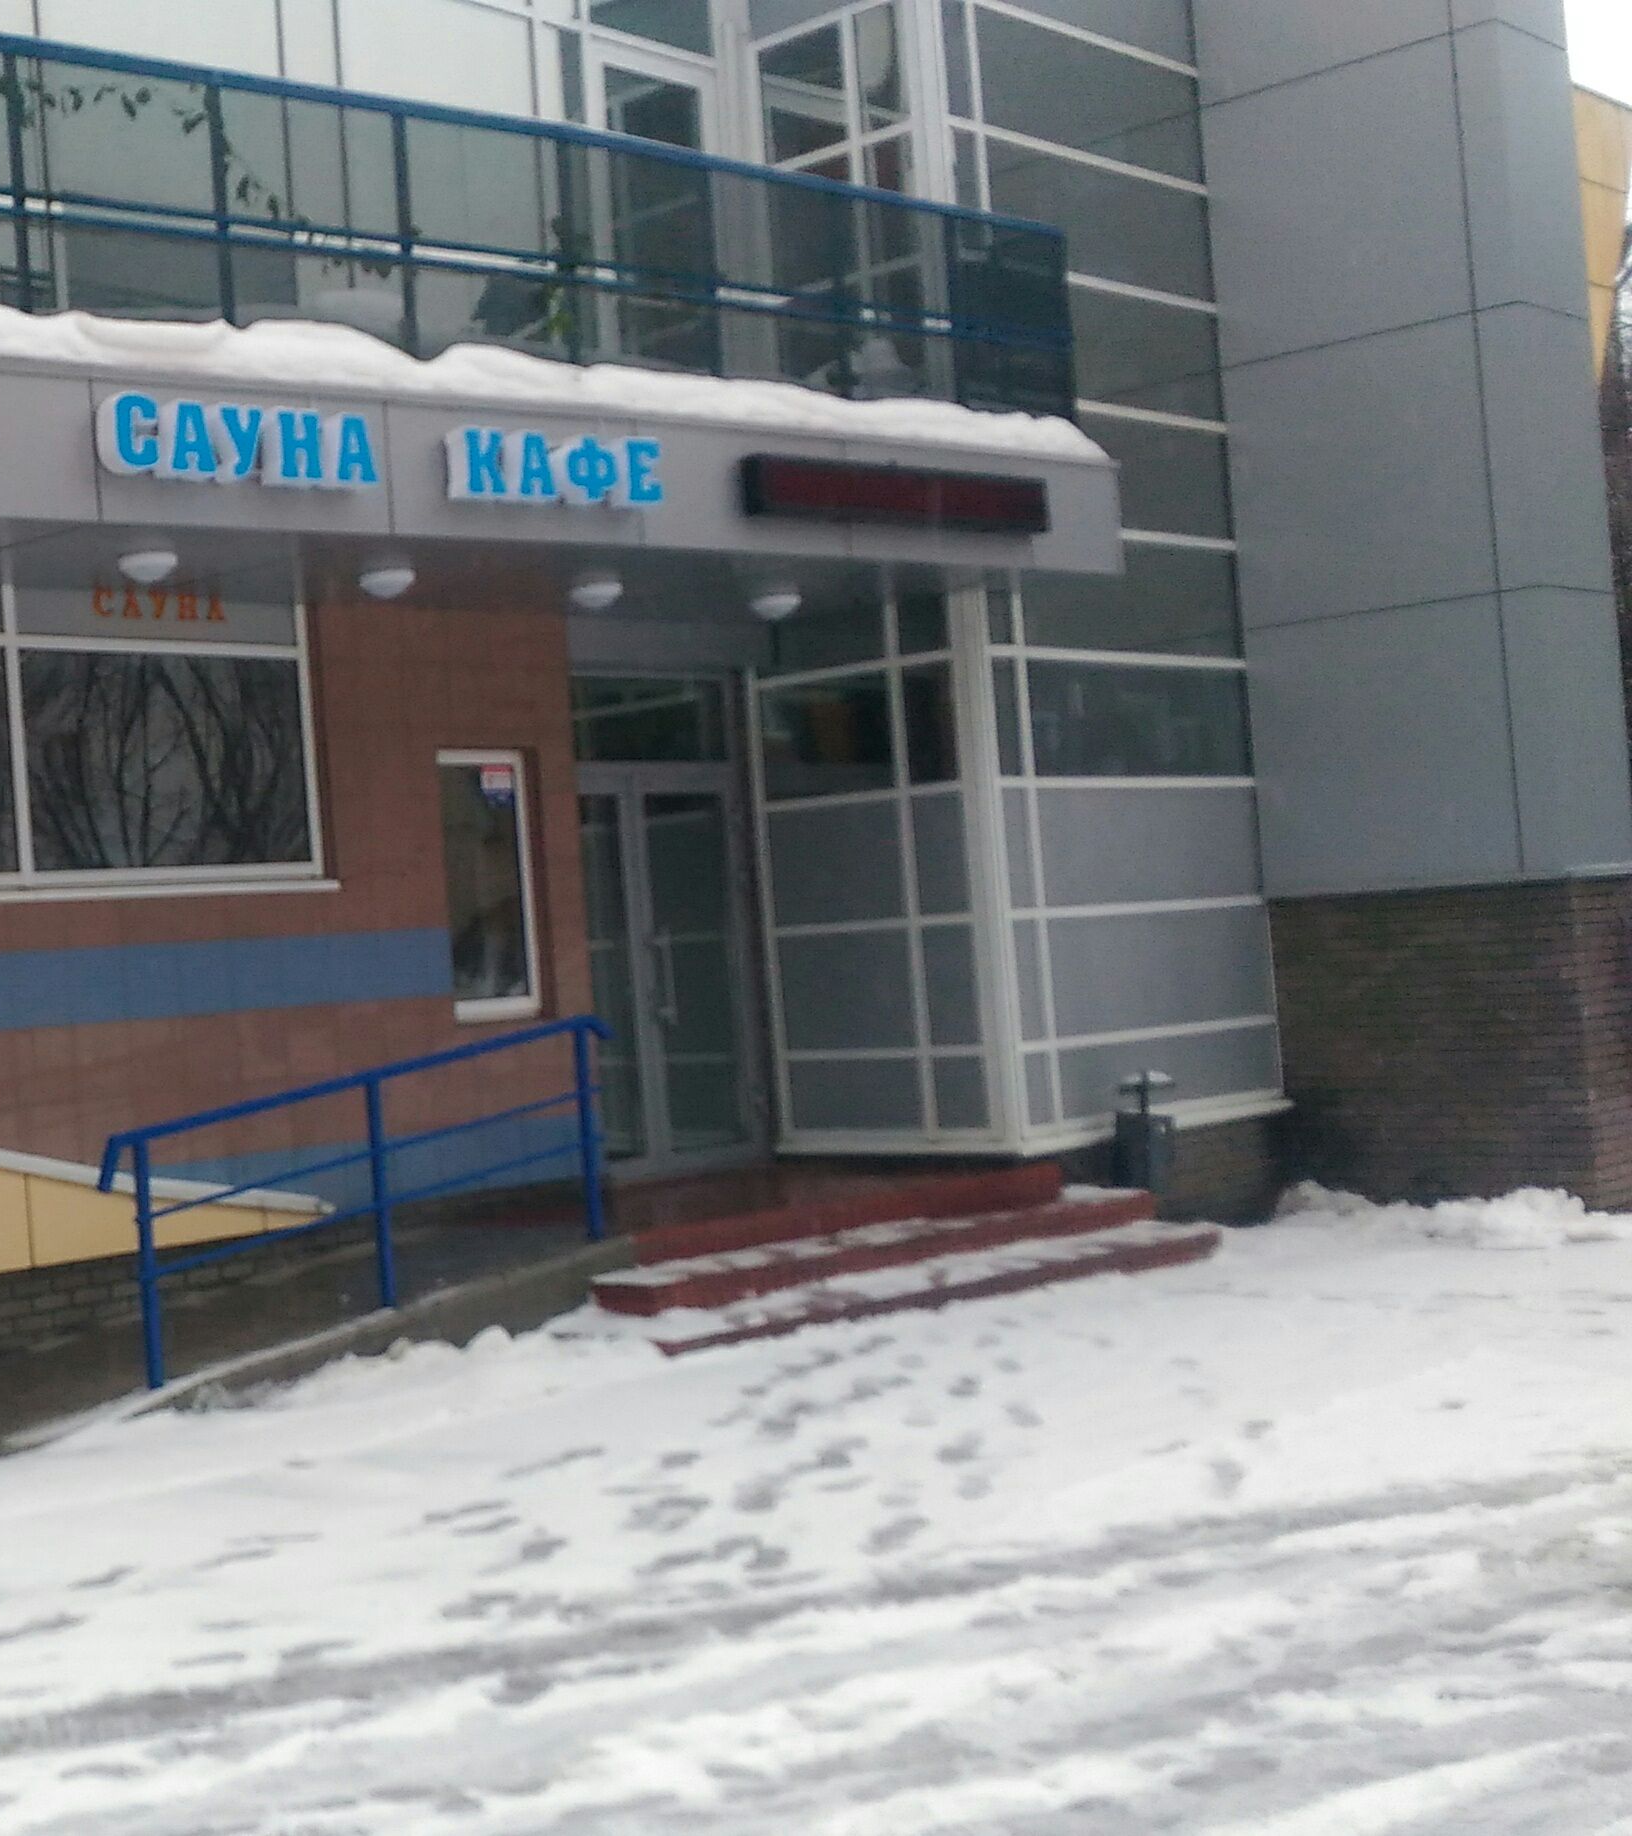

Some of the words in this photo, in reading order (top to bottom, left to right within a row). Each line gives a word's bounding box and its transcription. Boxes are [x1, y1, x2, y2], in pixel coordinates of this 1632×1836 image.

[106, 391, 380, 486] САУНА
[457, 425, 666, 503] КАФЕ
[92, 585, 228, 622] САУНА
